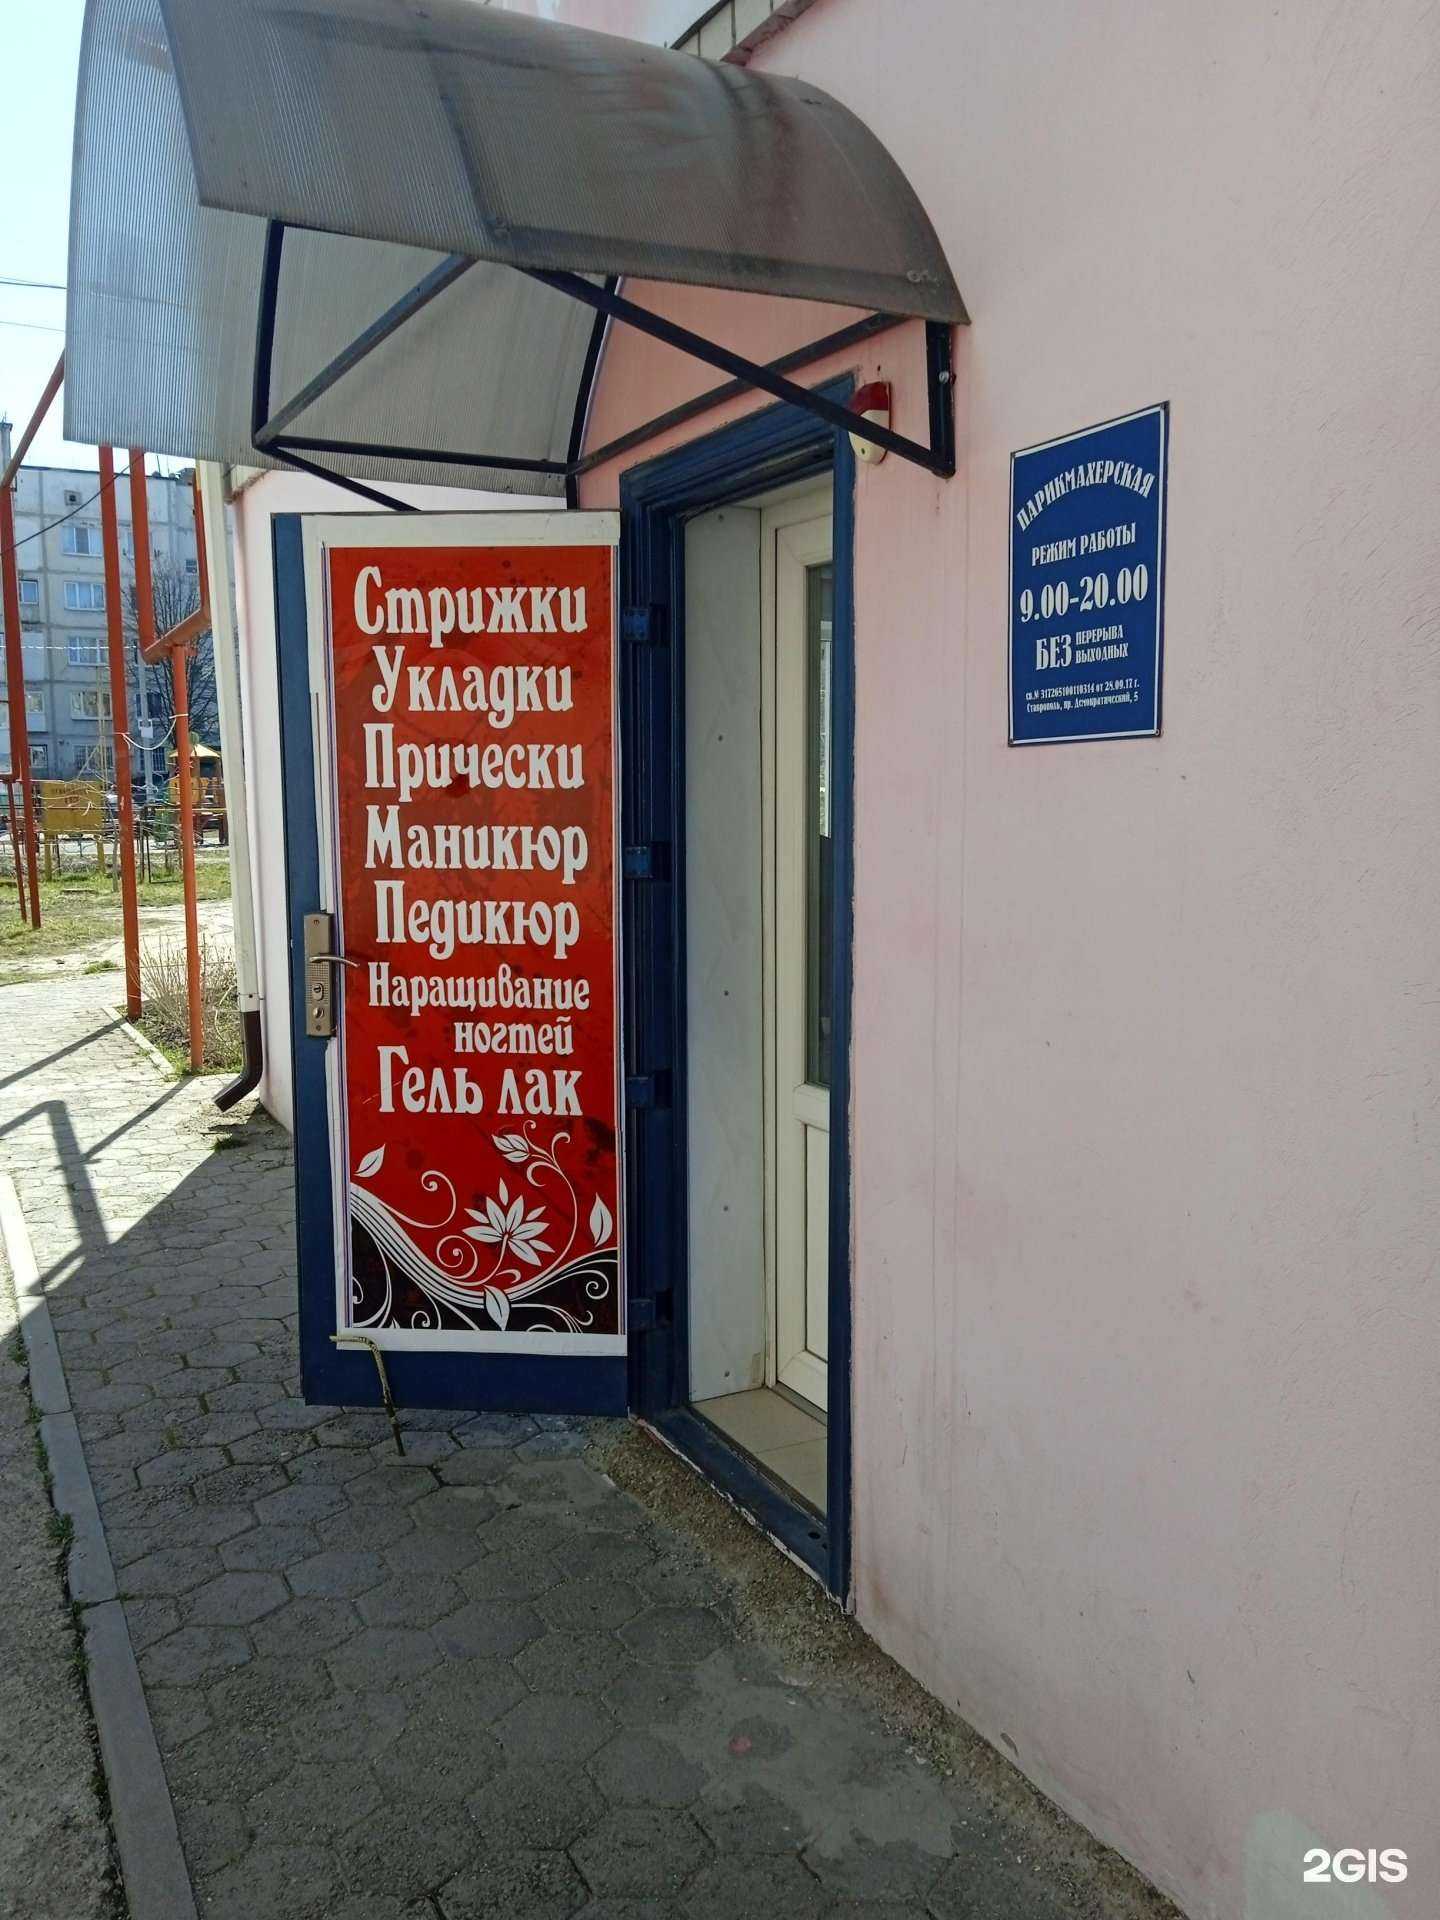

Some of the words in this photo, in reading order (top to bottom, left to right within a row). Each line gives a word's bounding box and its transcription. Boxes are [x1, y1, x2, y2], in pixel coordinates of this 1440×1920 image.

[1016, 460, 1155, 532] ПАРИКМАХЕРСКАЯ
[1032, 537, 1077, 567] РЕЖИМ
[1080, 522, 1137, 556] РАБОТЫ
[354, 566, 588, 648] Стрижки
[1020, 564, 1148, 622] 9.00-20.00
[1036, 634, 1072, 671] БЕЗ
[1075, 625, 1124, 645] ПЕРЕРЫВА
[1075, 643, 1129, 664] ВЫХОДНЫХ
[372, 645, 574, 729] Укладки
[1096, 683, 1104, 693] от
[1133, 691, 1139, 702] 5
[363, 723, 585, 802] Прически
[365, 805, 588, 885] Маникюр
[374, 880, 580, 960] Педикюр
[368, 962, 590, 1017] Наращивание
[454, 1015, 574, 1055] ногтей
[377, 1045, 484, 1114] Гель
[497, 1068, 583, 1116] лак
